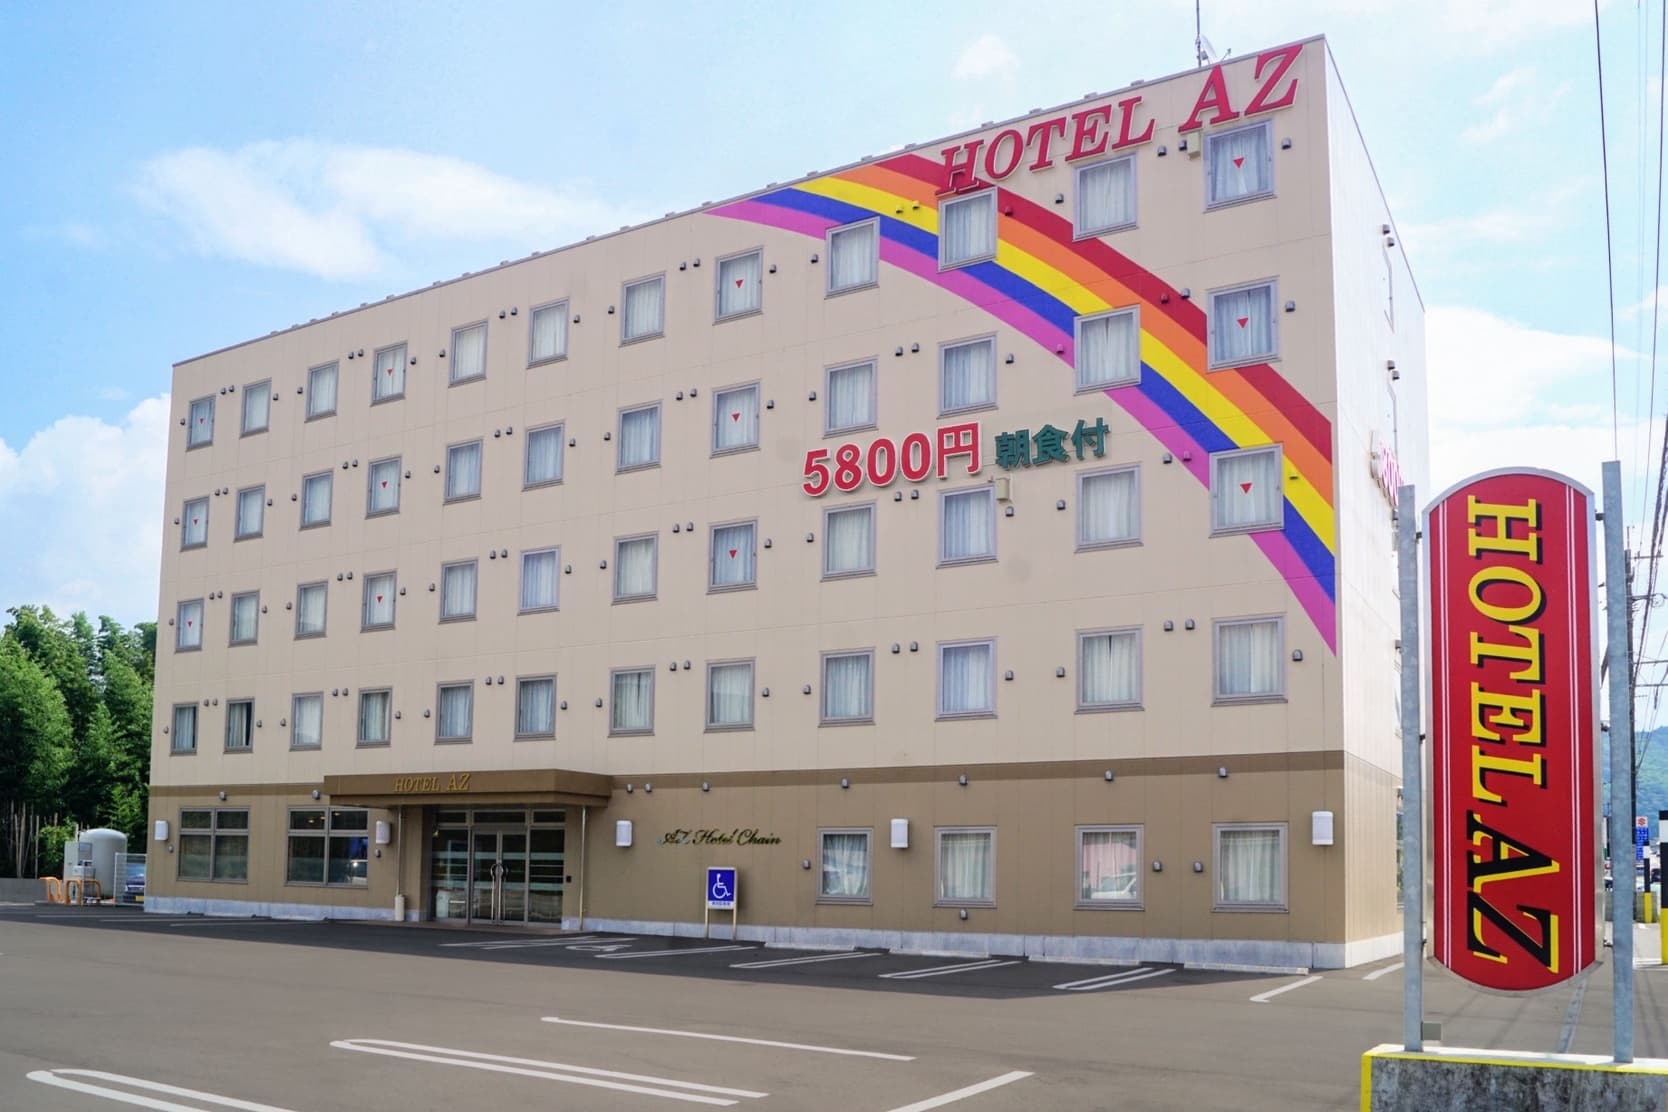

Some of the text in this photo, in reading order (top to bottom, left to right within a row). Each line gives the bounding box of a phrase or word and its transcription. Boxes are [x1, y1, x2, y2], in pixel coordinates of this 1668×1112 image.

[936, 44, 1304, 198] HOTEL AZ
[802, 417, 1110, 497] 5800円 朝食付
[1466, 495, 1560, 975] HOTEL AZ
[393, 773, 472, 793] HOTEL AZ
[692, 828, 738, 845] Hotel
[737, 828, 782, 845] Chain
